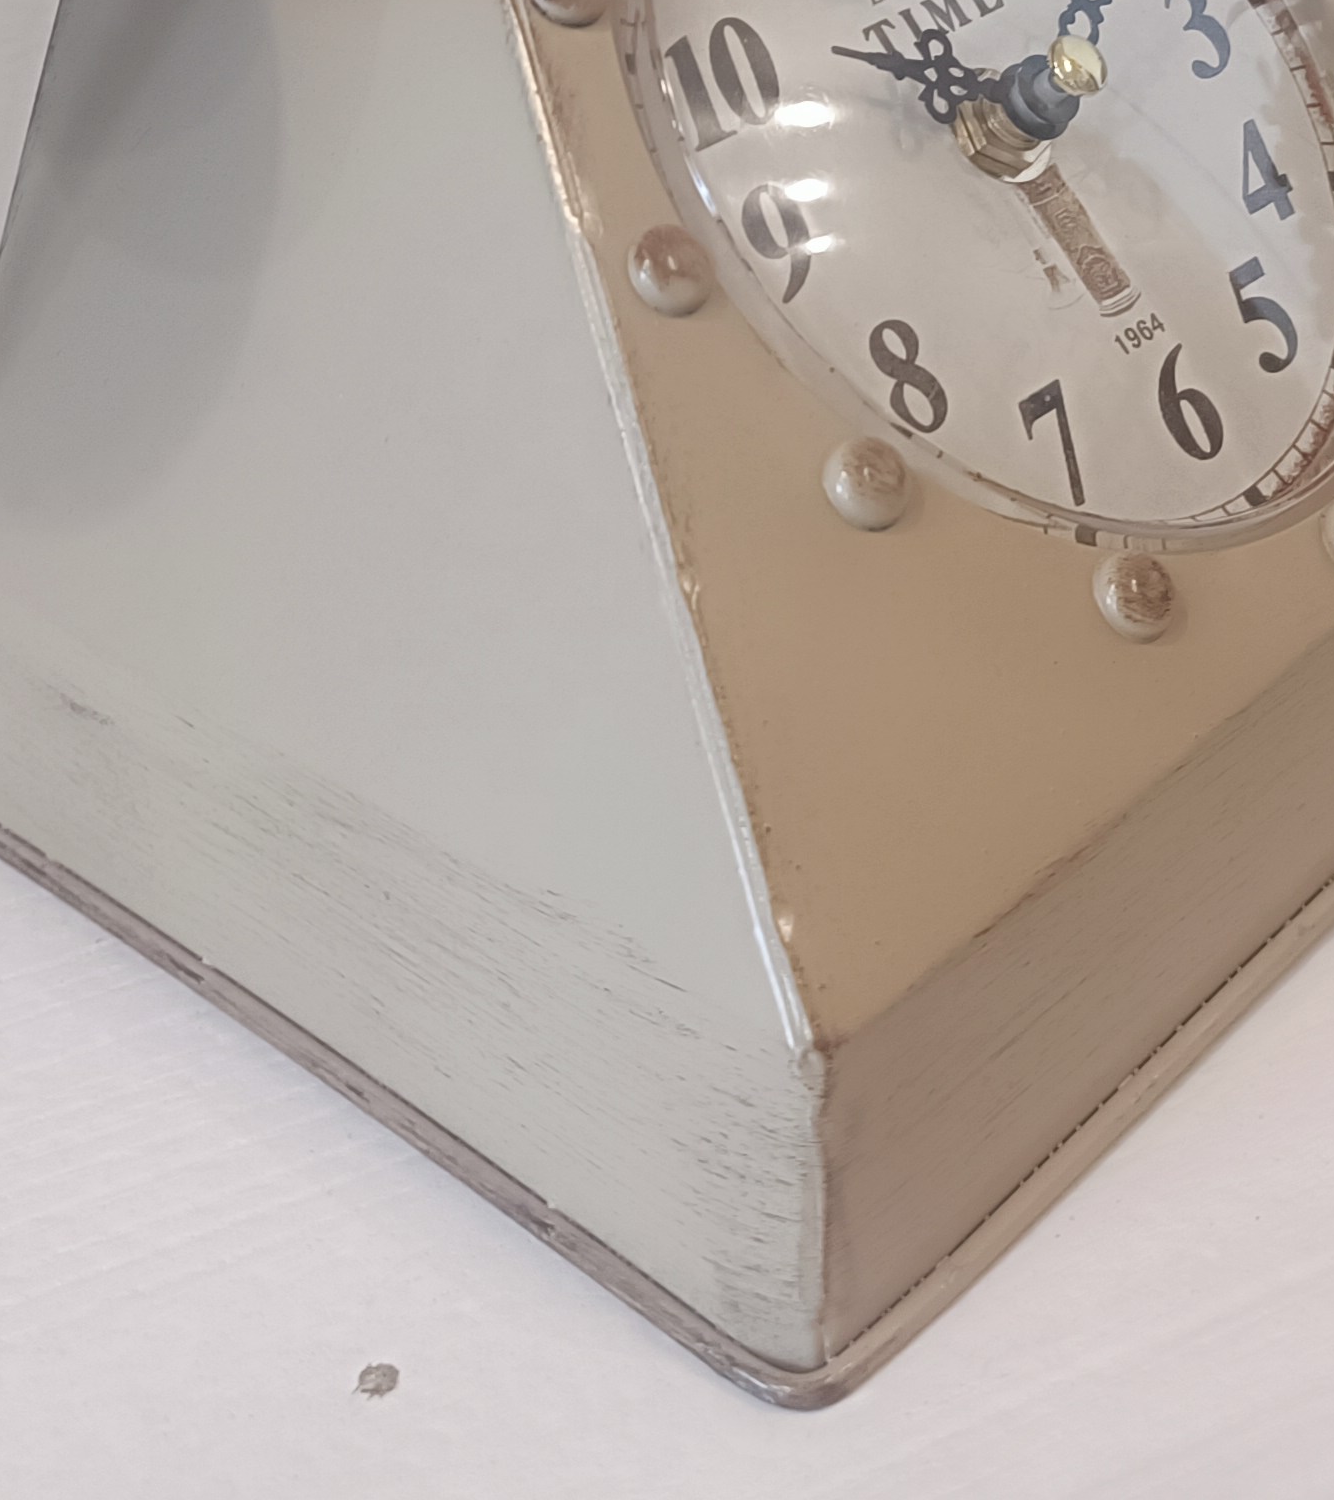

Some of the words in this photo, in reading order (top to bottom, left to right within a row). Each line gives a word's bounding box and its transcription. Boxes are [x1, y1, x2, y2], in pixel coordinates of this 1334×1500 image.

[665, 17, 779, 152] 10
[1242, 119, 1294, 220] 4
[741, 183, 812, 303] 9
[1114, 313, 1165, 354] 1964
[1229, 256, 1298, 373] 5
[868, 319, 948, 432] 8
[1158, 343, 1224, 460] 6
[1018, 379, 1085, 506] 7
